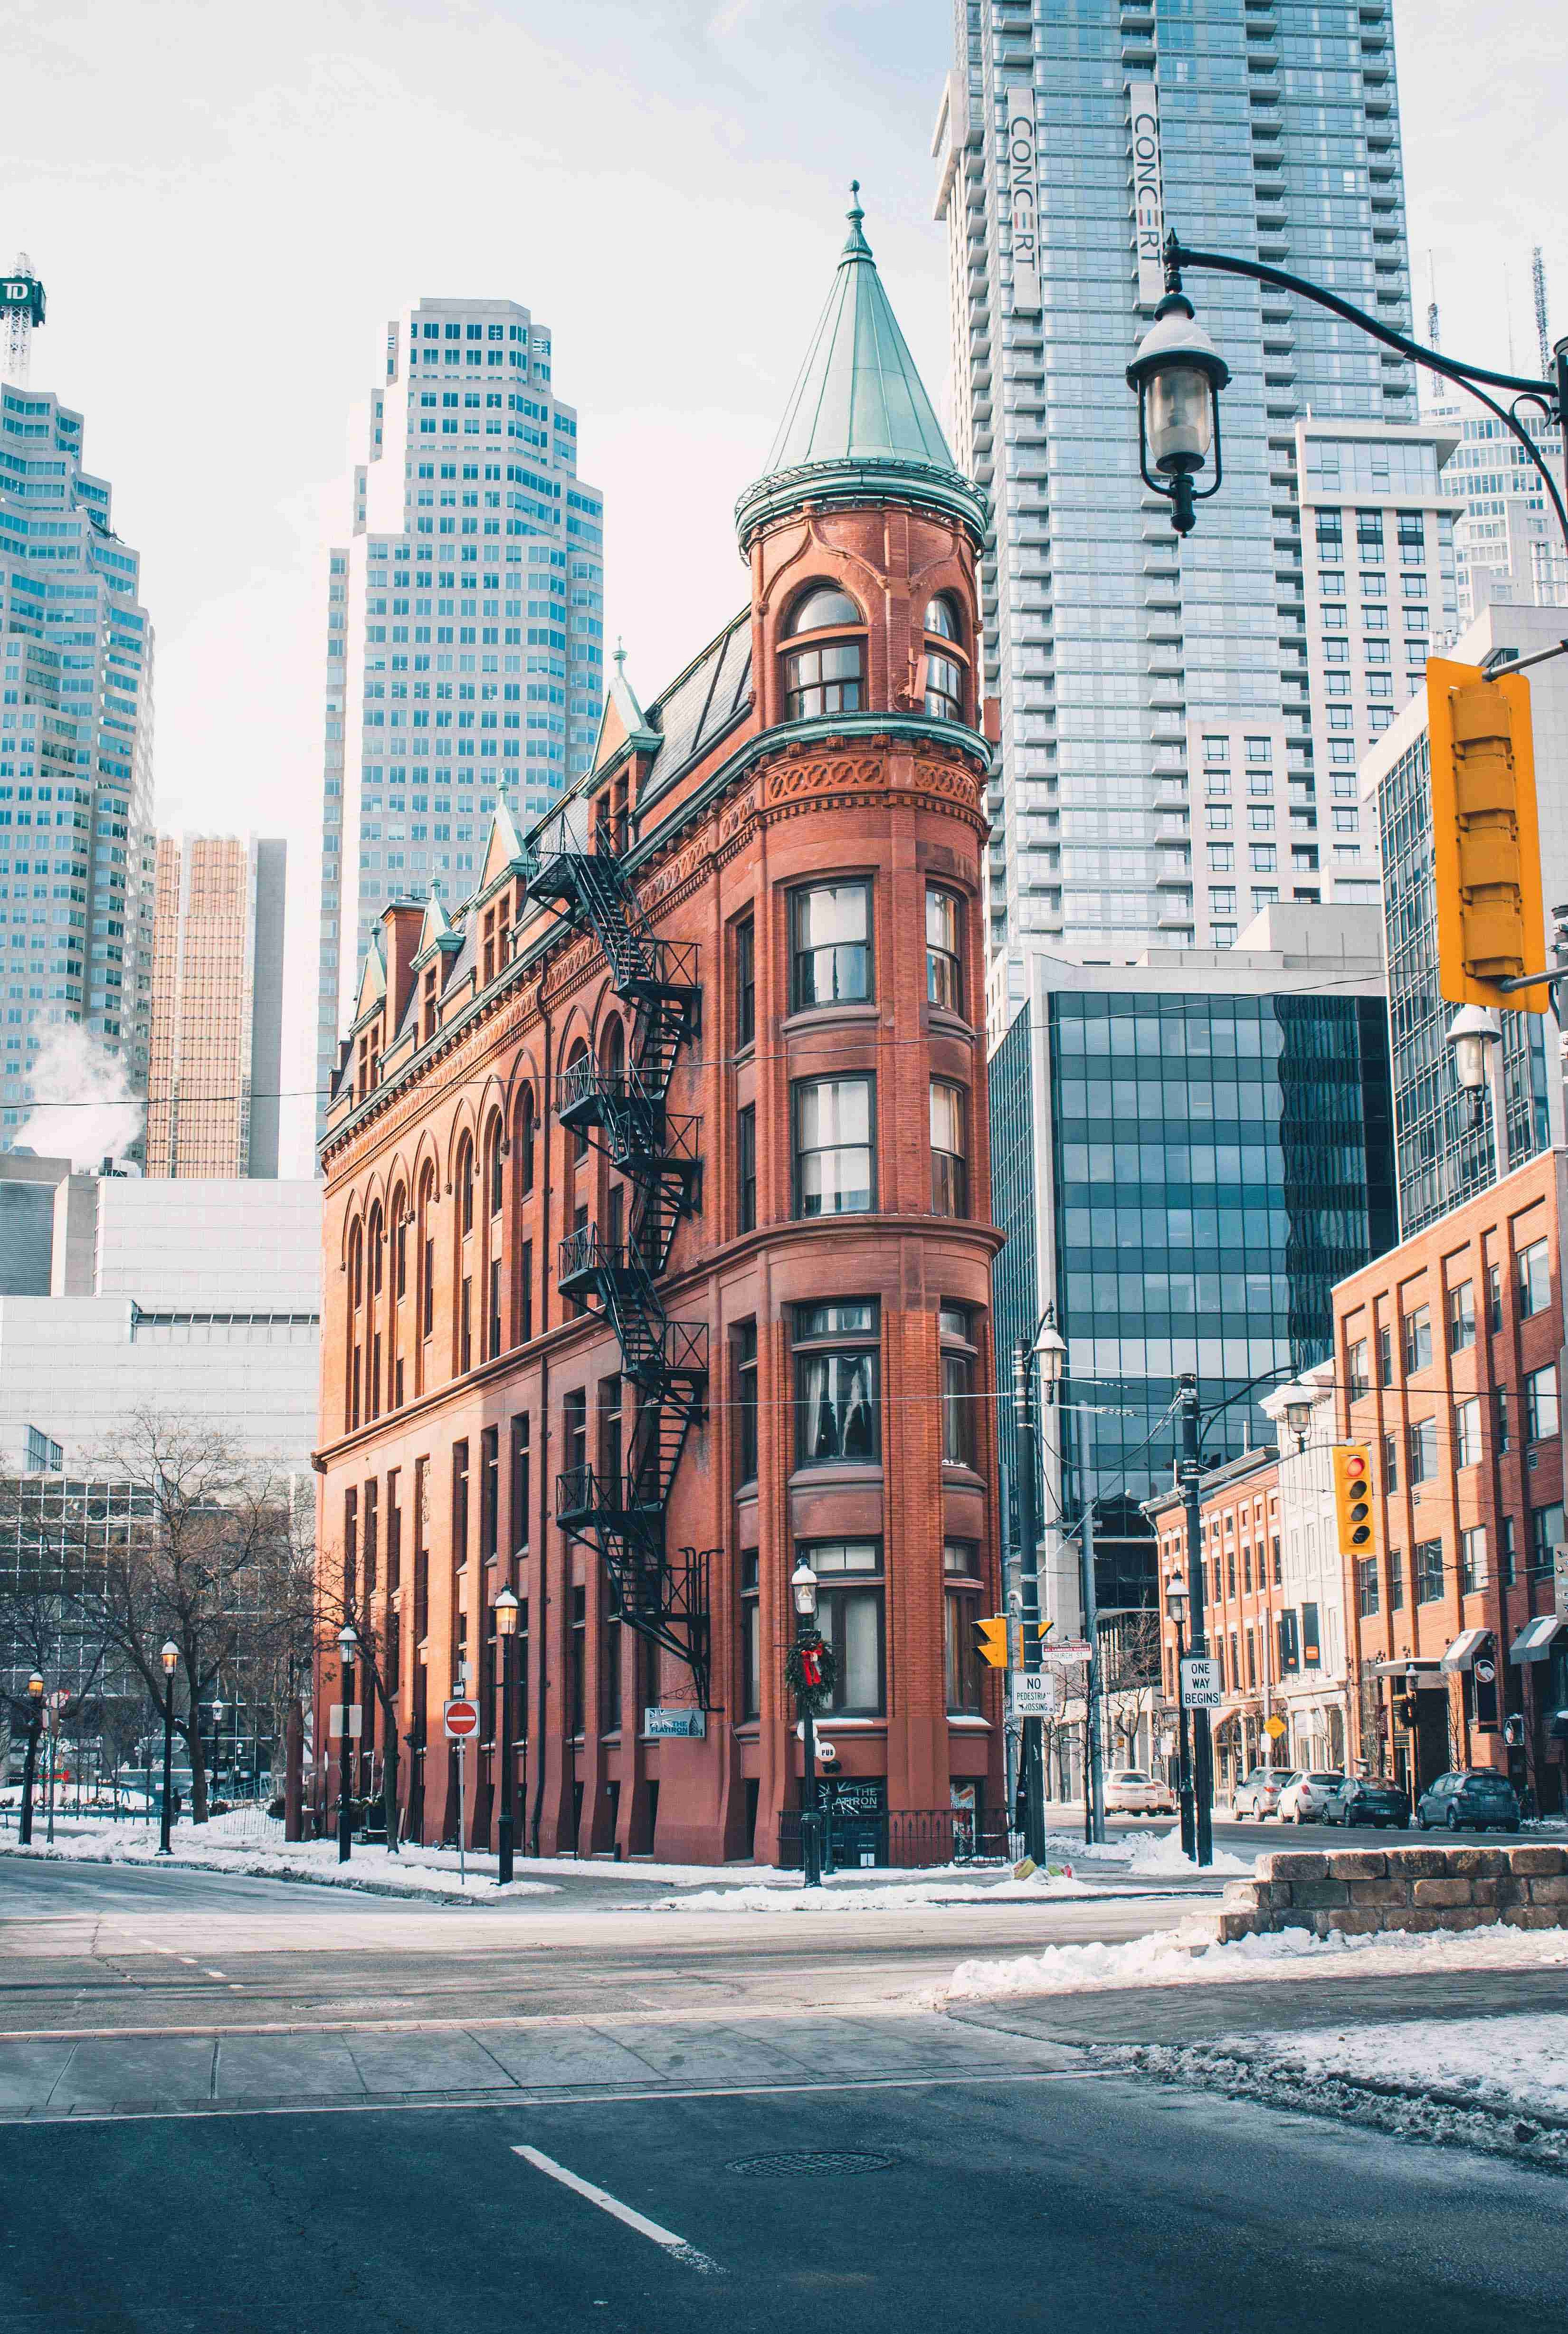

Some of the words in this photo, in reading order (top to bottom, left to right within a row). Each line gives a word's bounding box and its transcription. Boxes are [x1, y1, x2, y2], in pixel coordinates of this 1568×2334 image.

[1011, 116, 1035, 271] CONCERT
[1135, 114, 1160, 267] CONCERT
[2, 283, 28, 299] TD
[1191, 1664, 1210, 1674] ONE
[1027, 1678, 1041, 1689] NO
[1192, 1678, 1209, 1688] WAY
[1185, 1693, 1219, 1704] BEGINS
